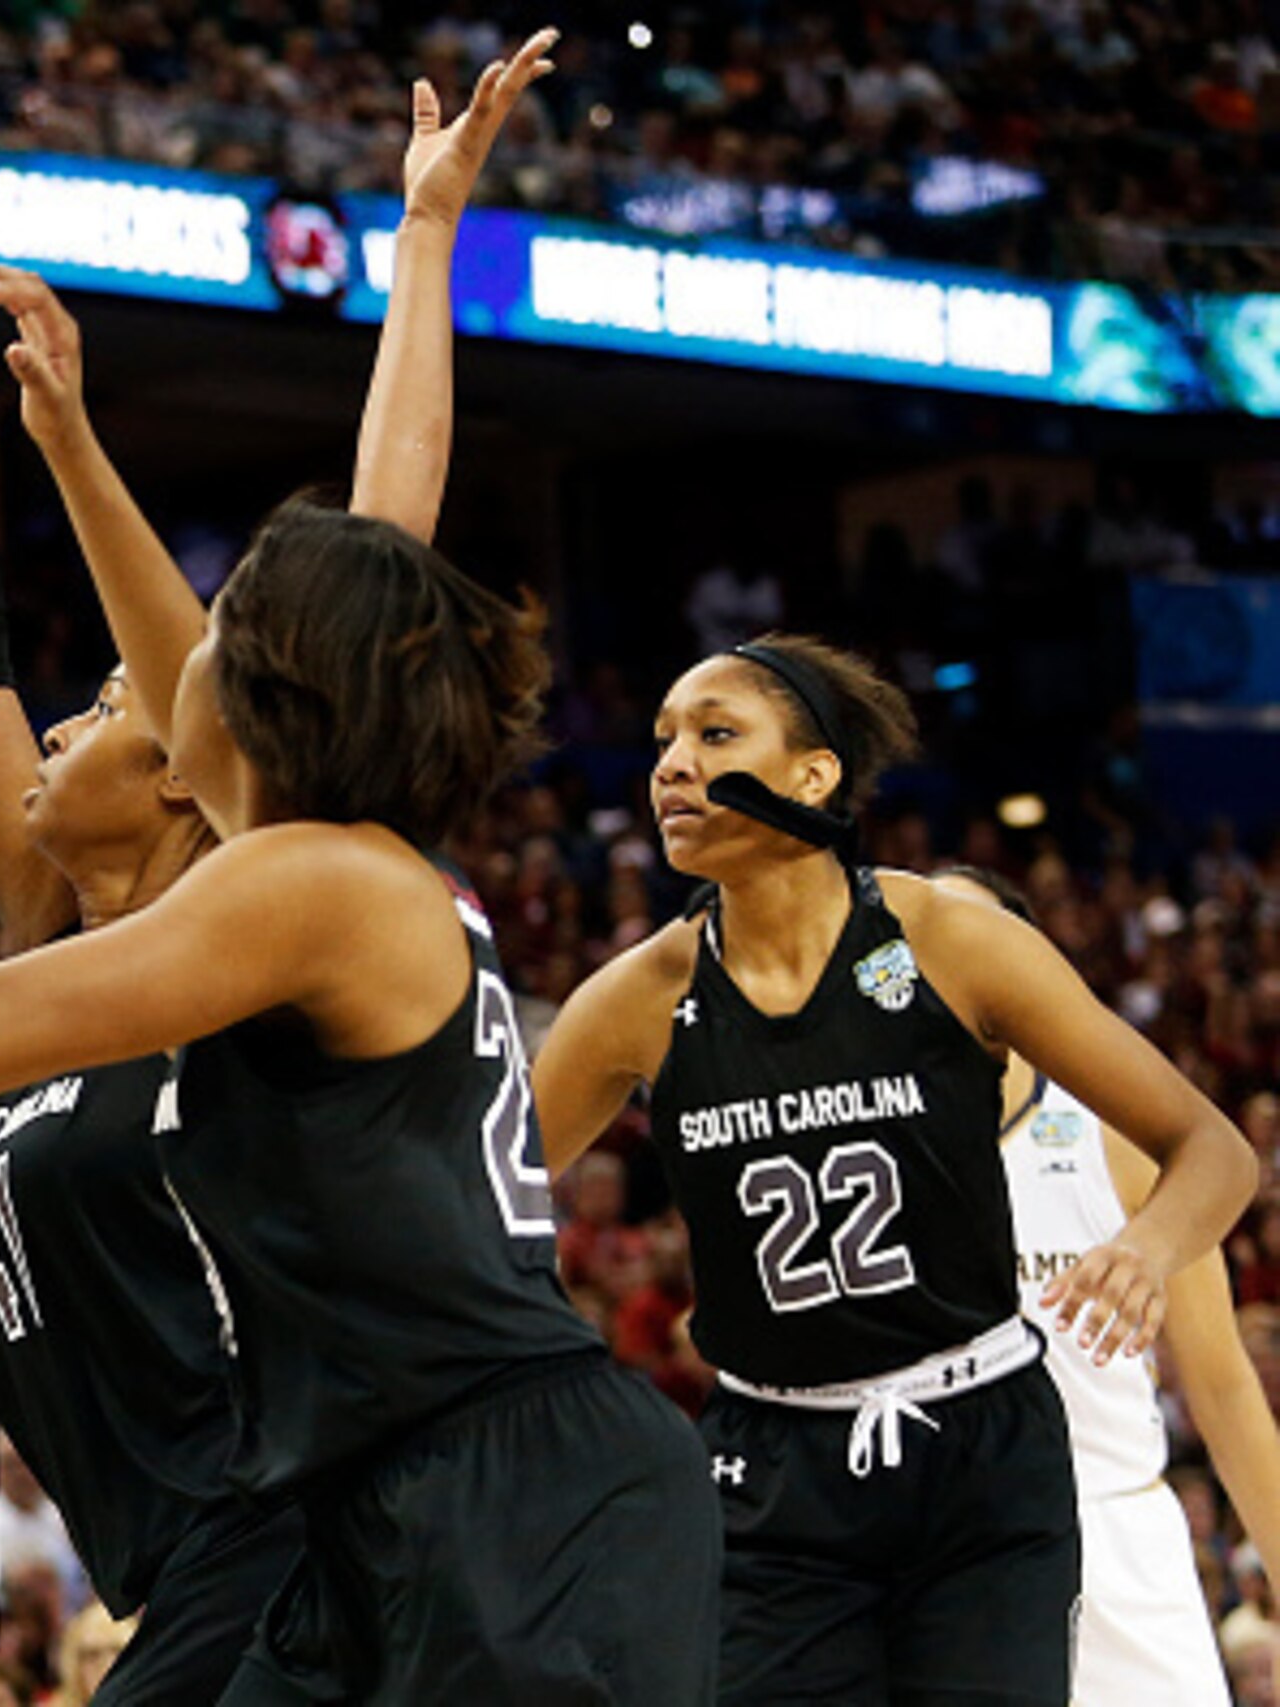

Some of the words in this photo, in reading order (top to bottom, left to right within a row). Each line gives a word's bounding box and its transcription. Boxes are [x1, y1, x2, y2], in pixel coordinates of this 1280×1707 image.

[679, 1098, 772, 1153] SOUTH
[777, 1073, 927, 1134] CAROLINA
[736, 1140, 916, 1314] 22
